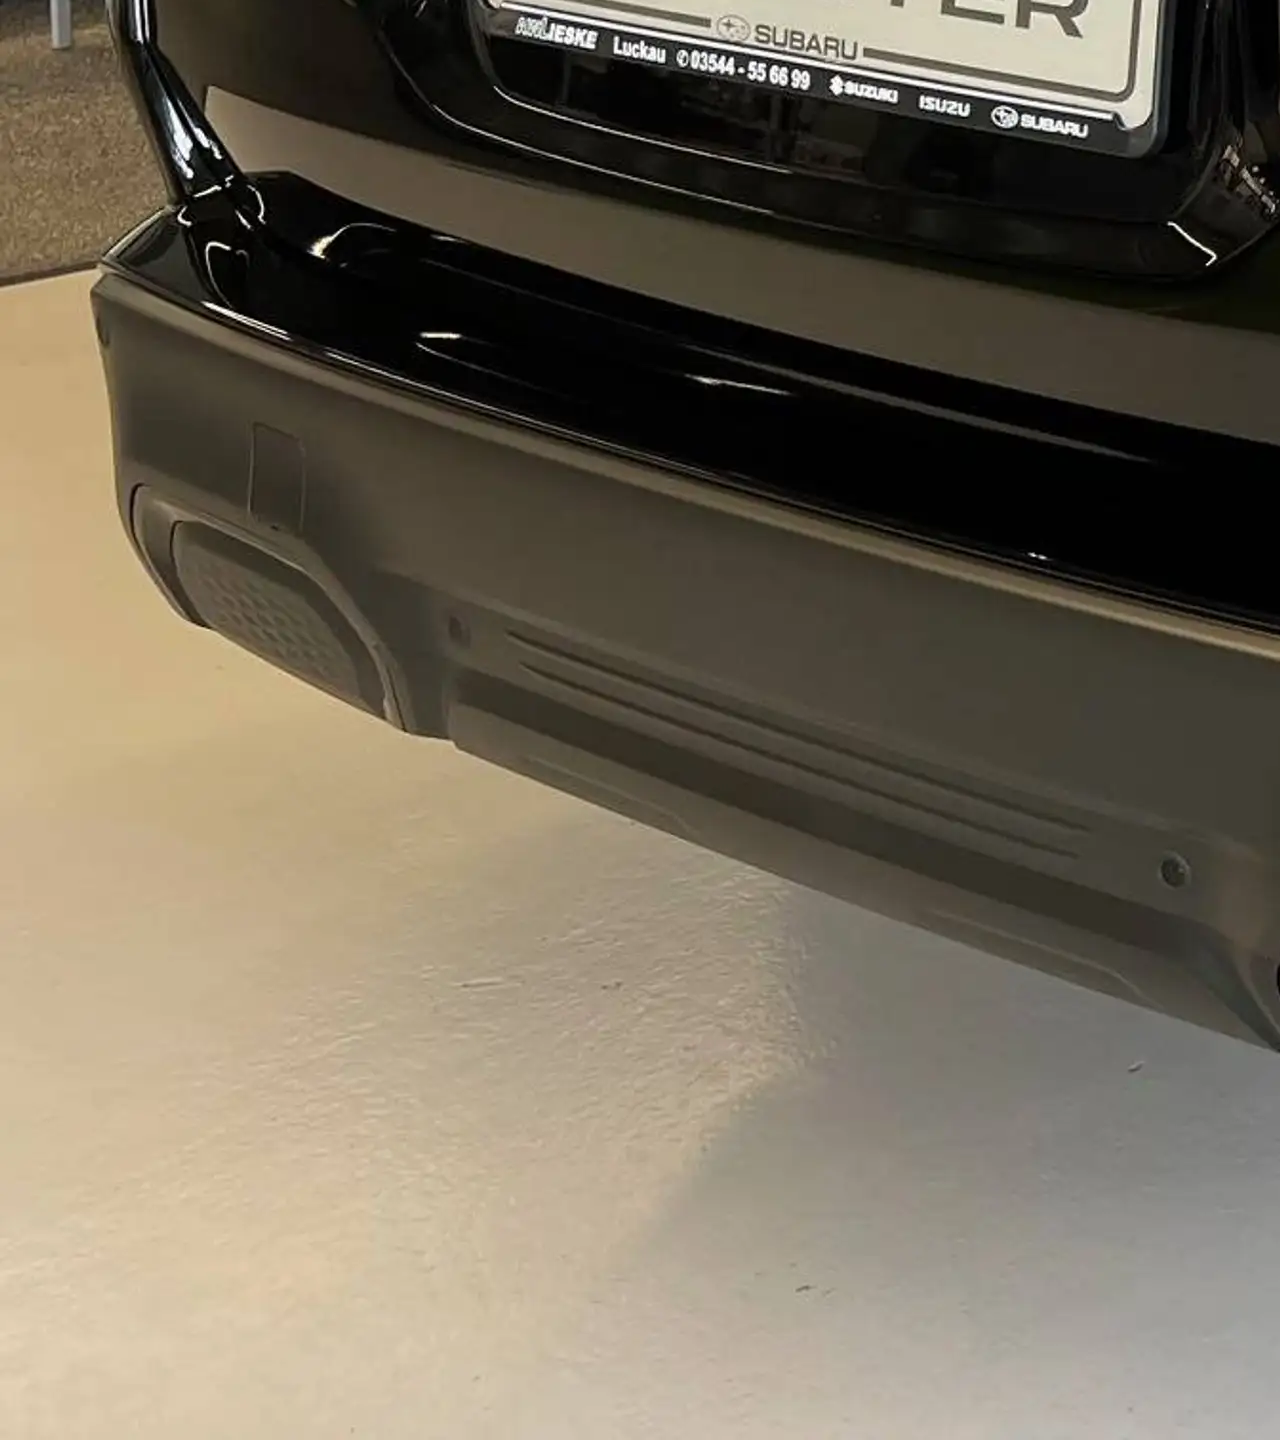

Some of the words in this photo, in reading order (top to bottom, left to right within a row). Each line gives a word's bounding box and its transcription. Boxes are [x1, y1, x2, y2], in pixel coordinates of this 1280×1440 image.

[754, 23, 858, 61] SUBARU
[613, 36, 666, 64] Luckau
[690, 49, 735, 76] 03544
[747, 61, 766, 82] 55
[769, 65, 788, 86] 66
[790, 69, 810, 91] 99
[844, 81, 899, 104] SUZUKI
[919, 95, 971, 117] ISUZU
[1020, 113, 1088, 138] SUBARU
